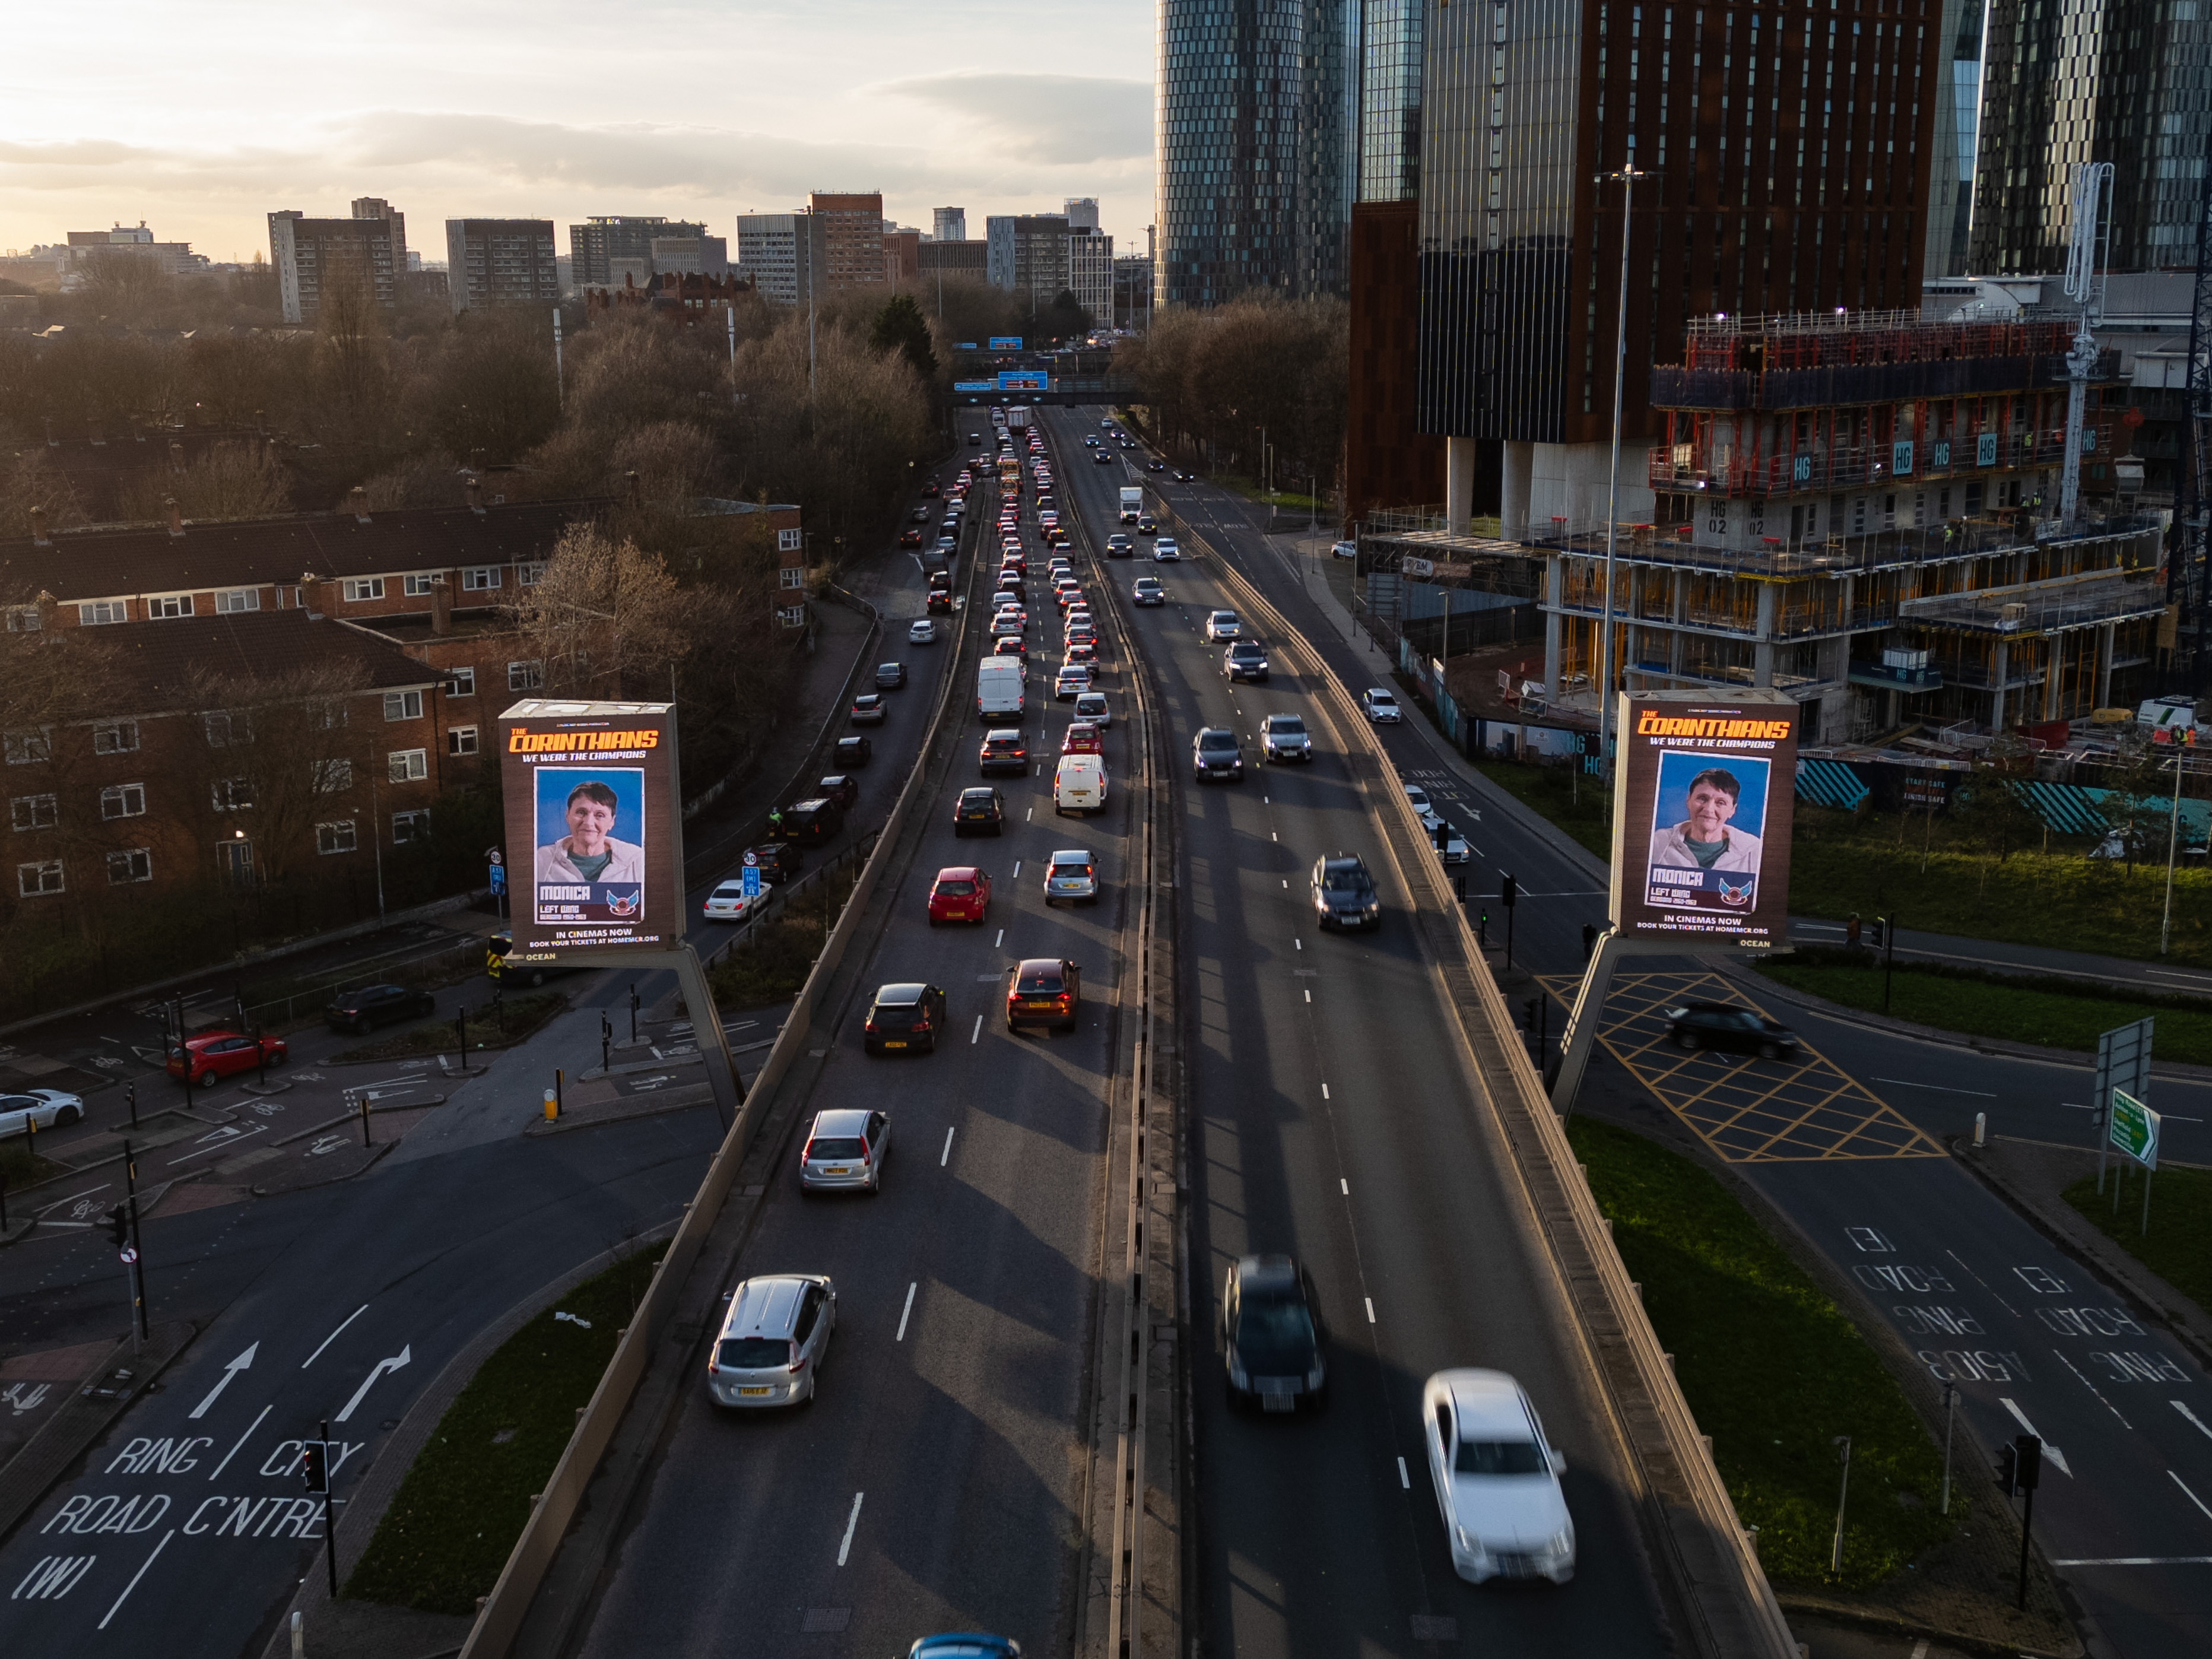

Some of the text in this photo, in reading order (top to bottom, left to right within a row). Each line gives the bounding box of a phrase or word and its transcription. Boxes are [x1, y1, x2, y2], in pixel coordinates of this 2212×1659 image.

[2083, 430, 2096, 451] HG
[1896, 446, 1910, 470] HG
[1935, 443, 1949, 465] HG
[1980, 439, 1994, 461] HG
[1794, 456, 1810, 480] HG
[1710, 500, 1726, 518] HG
[1751, 501, 1763, 519] HG
[1709, 519, 1727, 534] 02
[1749, 521, 1763, 536] 02
[1897, 668, 1907, 680] HG
[1637, 716, 1791, 739] CORINTHIANS
[508, 729, 659, 753] CORINTHIANS
[1650, 737, 1776, 749] WE WERE THE CHAMPIONS
[522, 750, 646, 763] WE WERE THE CHAMPIONS
[1430, 791, 1470, 800] CITY
[1652, 868, 1703, 886] MONICA
[539, 886, 591, 900] MONICA
[1651, 887, 1670, 896] LEFT
[539, 905, 558, 913] LEFT
[1676, 915, 1716, 924] CINEMAS
[1718, 918, 1742, 926] NOW
[568, 930, 608, 938] CINEMAS
[1716, 926, 1768, 934] HOMEMCR.ORG
[608, 935, 659, 944] HOMEMCR.ORG
[1740, 940, 1770, 948] OCEAN
[526, 952, 556, 961] OCEAN
[1852, 1265, 1956, 1292] ROAD
[2013, 1267, 2073, 1293] (E)
[1893, 1306, 1986, 1334] RING
[2035, 1308, 2147, 1336] ROAD
[1918, 1350, 2032, 1382] A5103
[2089, 1352, 2192, 1382] RING
[105, 1437, 214, 1474] RING
[40, 1494, 172, 1534] ROAD
[182, 1496, 347, 1539] C'NTRE
[11, 1555, 96, 1600] (W)
